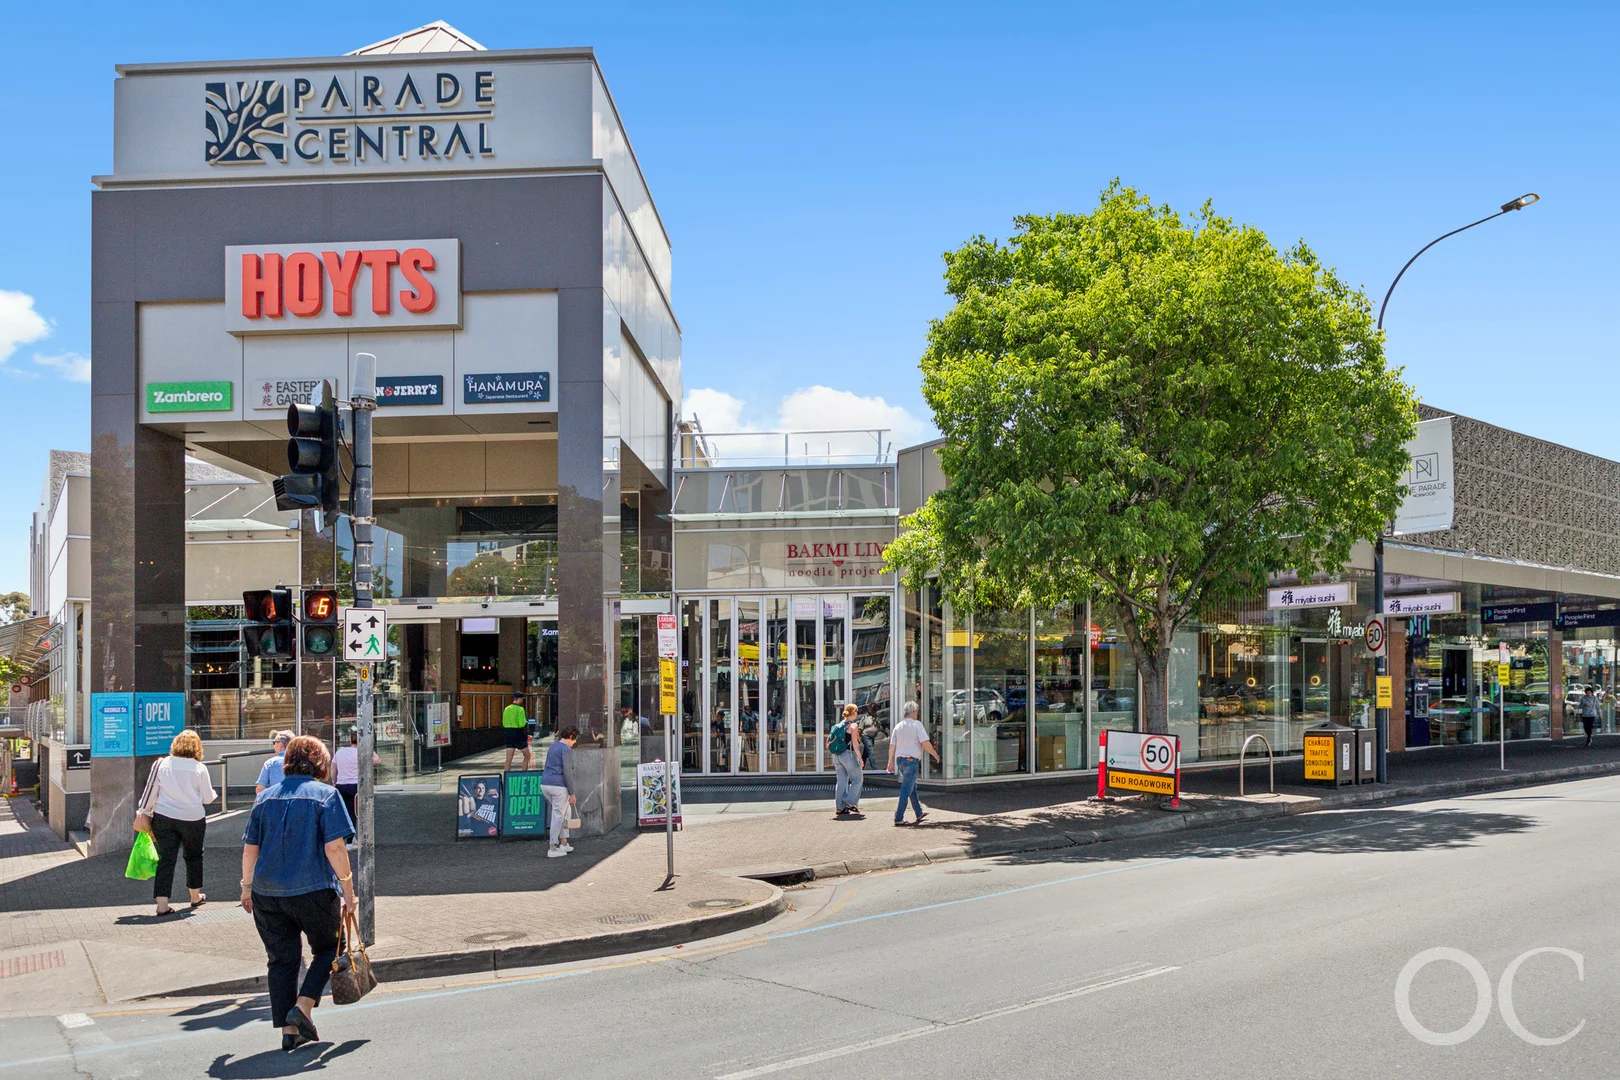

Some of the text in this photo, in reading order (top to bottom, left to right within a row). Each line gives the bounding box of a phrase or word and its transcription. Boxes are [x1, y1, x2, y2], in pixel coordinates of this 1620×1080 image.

[293, 71, 495, 112] PARADE
[293, 121, 495, 163] CENTRAL
[241, 247, 439, 319] HOYTS
[276, 381, 321, 394] EASTER
[394, 384, 438, 396] JERRY'S
[468, 379, 543, 393] HANAMURA
[153, 391, 223, 403] Zambrero
[276, 393, 312, 406] GARDE
[1418, 482, 1448, 493] PARADE
[787, 541, 889, 559] BAKMI LIM
[789, 567, 834, 576] noodle
[1295, 593, 1336, 606] miyabi sushi
[317, 598, 330, 615] 6
[1403, 602, 1442, 613] miyabi sushi
[1342, 622, 1365, 639] miyabi
[1368, 628, 1381, 643] 50
[361, 669, 368, 679] 8
[145, 702, 171, 722] OPEN
[104, 740, 121, 749] OPEN
[1145, 744, 1170, 764] 50
[1309, 749, 1329, 757] TRAFFIC
[1305, 759, 1334, 767] CONDITIONS
[1311, 769, 1328, 777] AHEAD
[1110, 775, 1172, 790] END ROADWORK
[509, 796, 540, 816] OPEN
